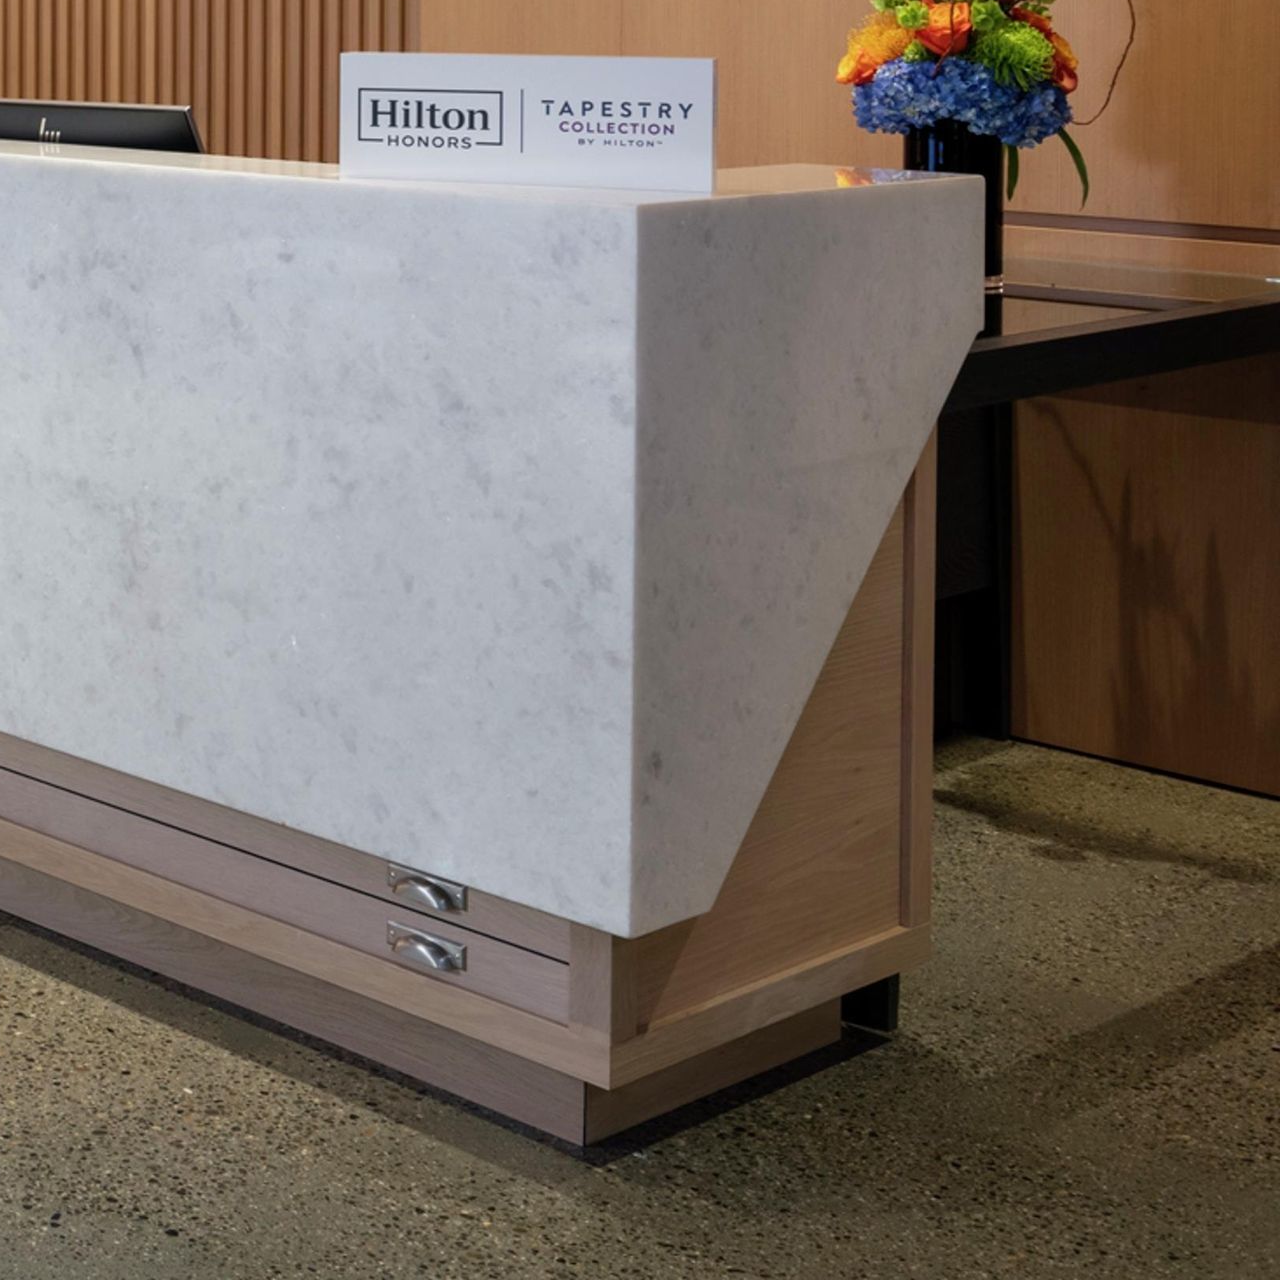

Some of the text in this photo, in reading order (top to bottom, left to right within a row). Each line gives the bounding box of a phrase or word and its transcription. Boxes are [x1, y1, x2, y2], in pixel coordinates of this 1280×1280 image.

[369, 99, 491, 131] Hilton
[541, 99, 694, 120] TAPESTRY
[558, 120, 676, 136] COLLECTION
[387, 134, 472, 149] HONORS
[577, 138, 595, 146] BY
